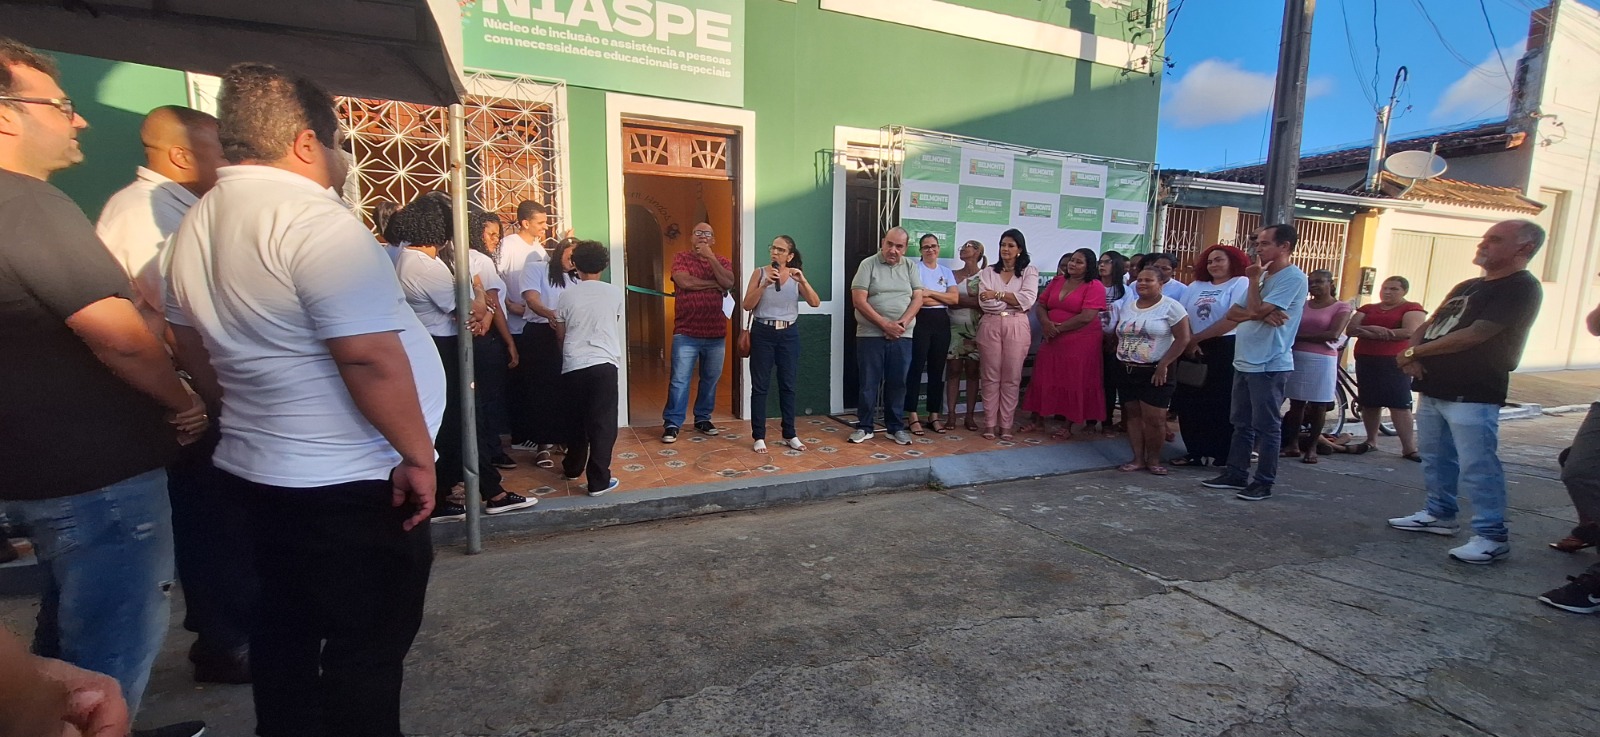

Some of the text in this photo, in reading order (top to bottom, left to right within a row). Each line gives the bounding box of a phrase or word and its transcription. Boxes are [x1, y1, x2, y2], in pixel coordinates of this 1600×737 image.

[483, 17, 732, 66] Núcleo de inclusão e assistência a pessoas
[484, 34, 732, 78] com necessidades educacionais especiais
[922, 154, 951, 164] BELMONTE
[978, 161, 1006, 171] BELMONTE
[1029, 167, 1055, 176] BELMONTE
[1077, 172, 1101, 181] BELMONTE
[919, 193, 949, 202] BELMONTE
[975, 198, 1003, 207] BELMONTE
[1026, 202, 1052, 211] BELMONTE
[1073, 207, 1098, 215] BELMONTE
